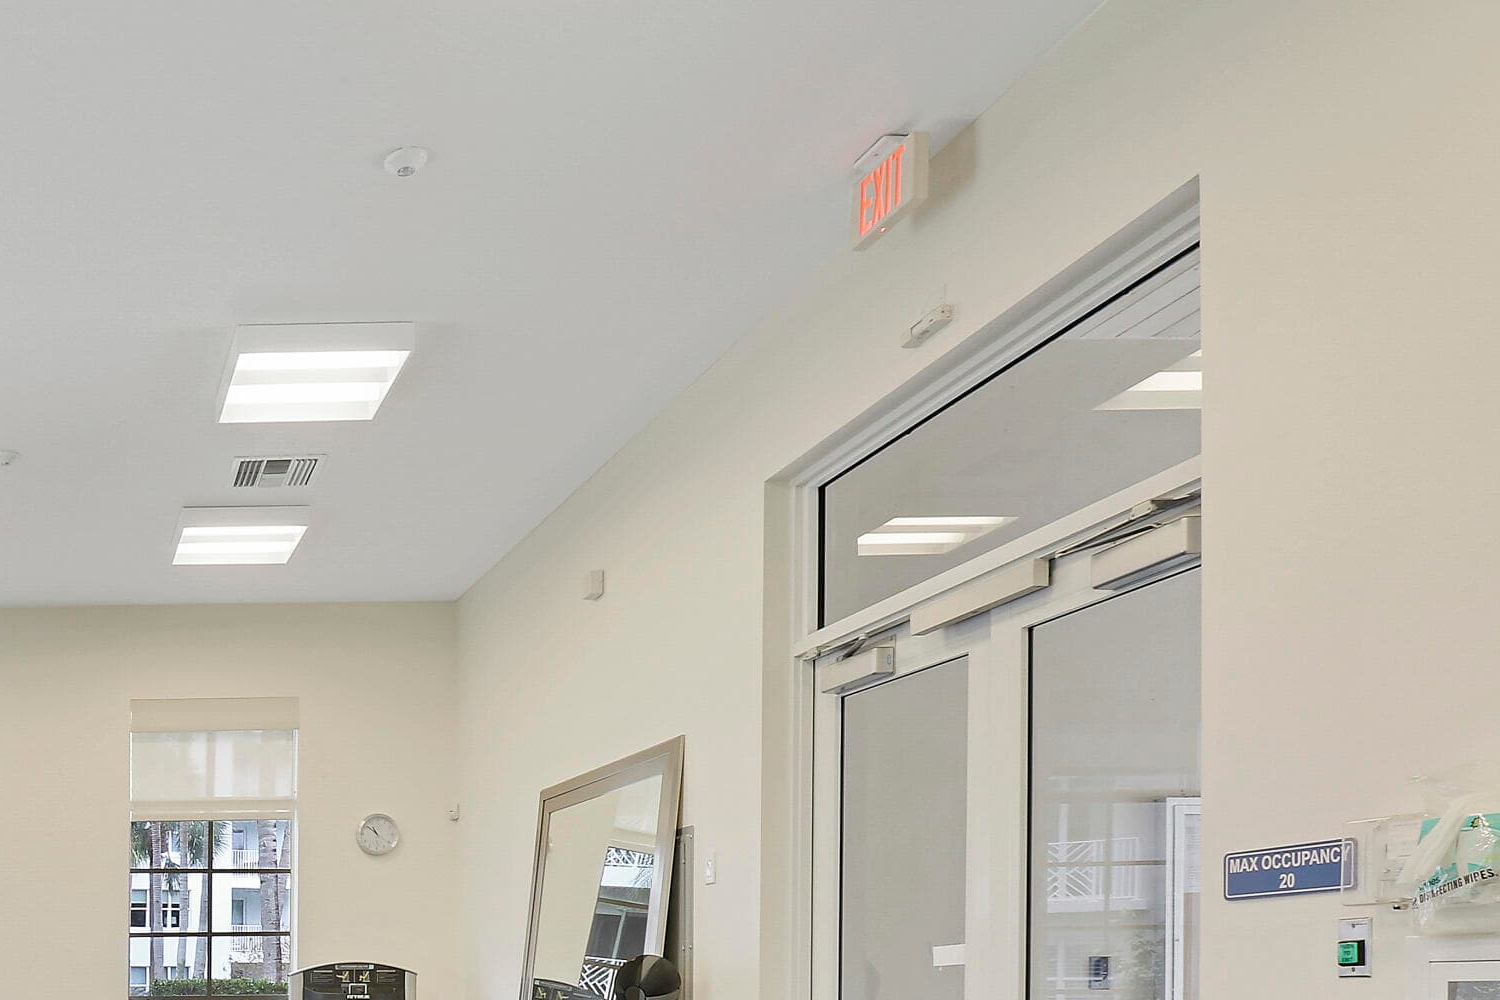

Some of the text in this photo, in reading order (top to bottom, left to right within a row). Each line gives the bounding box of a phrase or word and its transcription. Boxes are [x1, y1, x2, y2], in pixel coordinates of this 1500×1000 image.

[859, 143, 906, 237] EXIT
[1229, 845, 1351, 873] MAX OCCUPANCY
[1279, 873, 1295, 888] 20
